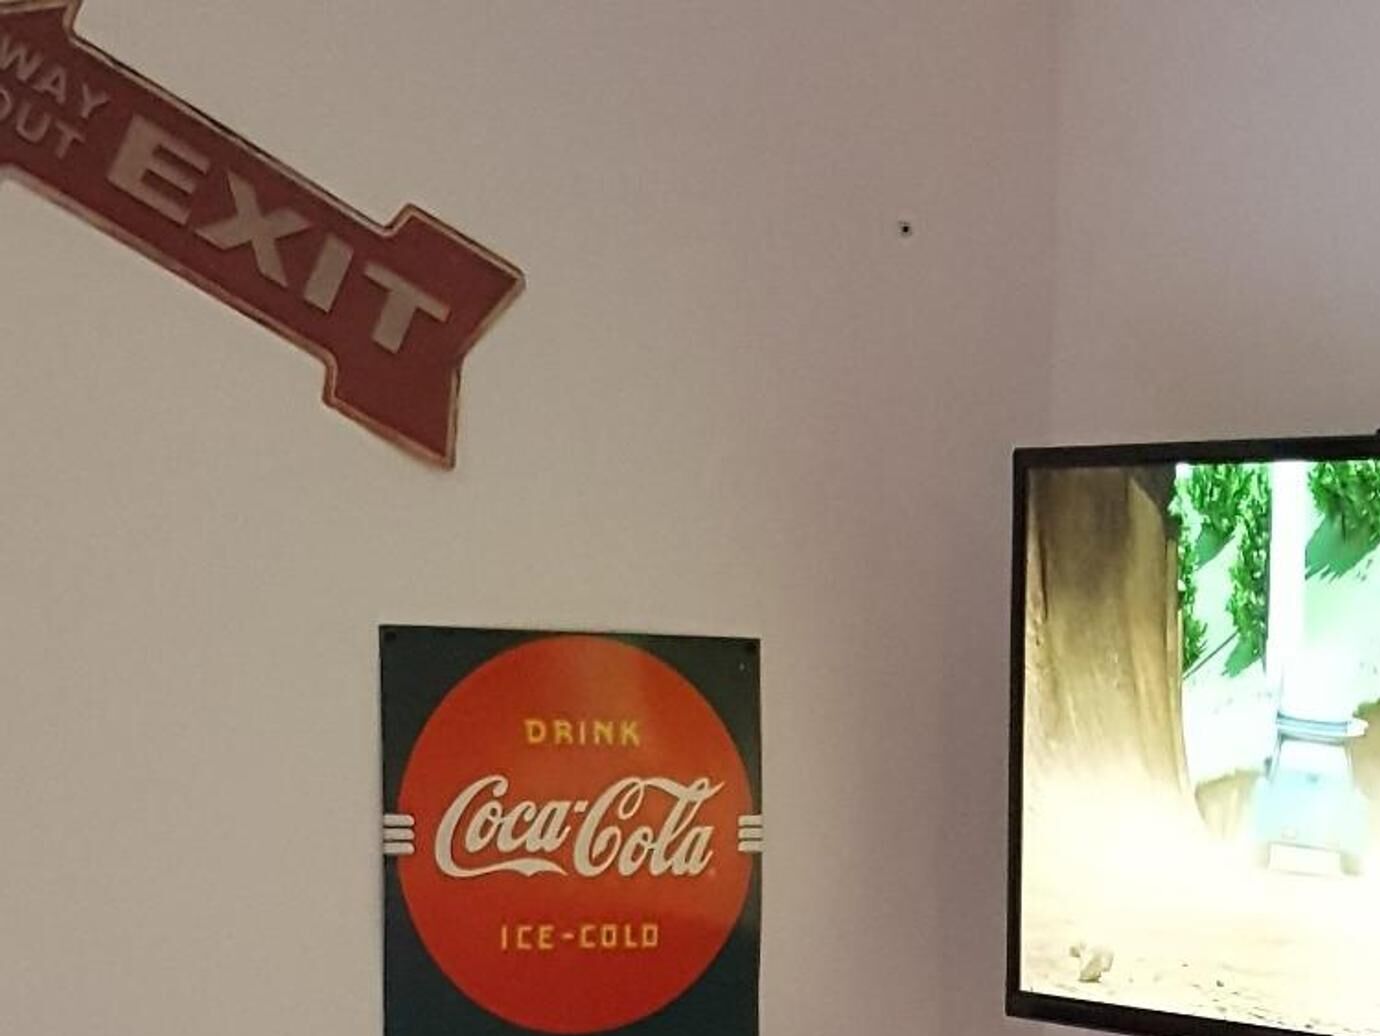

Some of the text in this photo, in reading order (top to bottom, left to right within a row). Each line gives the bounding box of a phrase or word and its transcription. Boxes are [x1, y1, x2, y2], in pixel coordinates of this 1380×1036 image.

[0, 36, 110, 119] WAY
[107, 114, 450, 354] EXIT
[524, 719, 642, 745] DRINK
[435, 774, 724, 878] Coca-Cola
[501, 923, 659, 951] ICE-COLD
